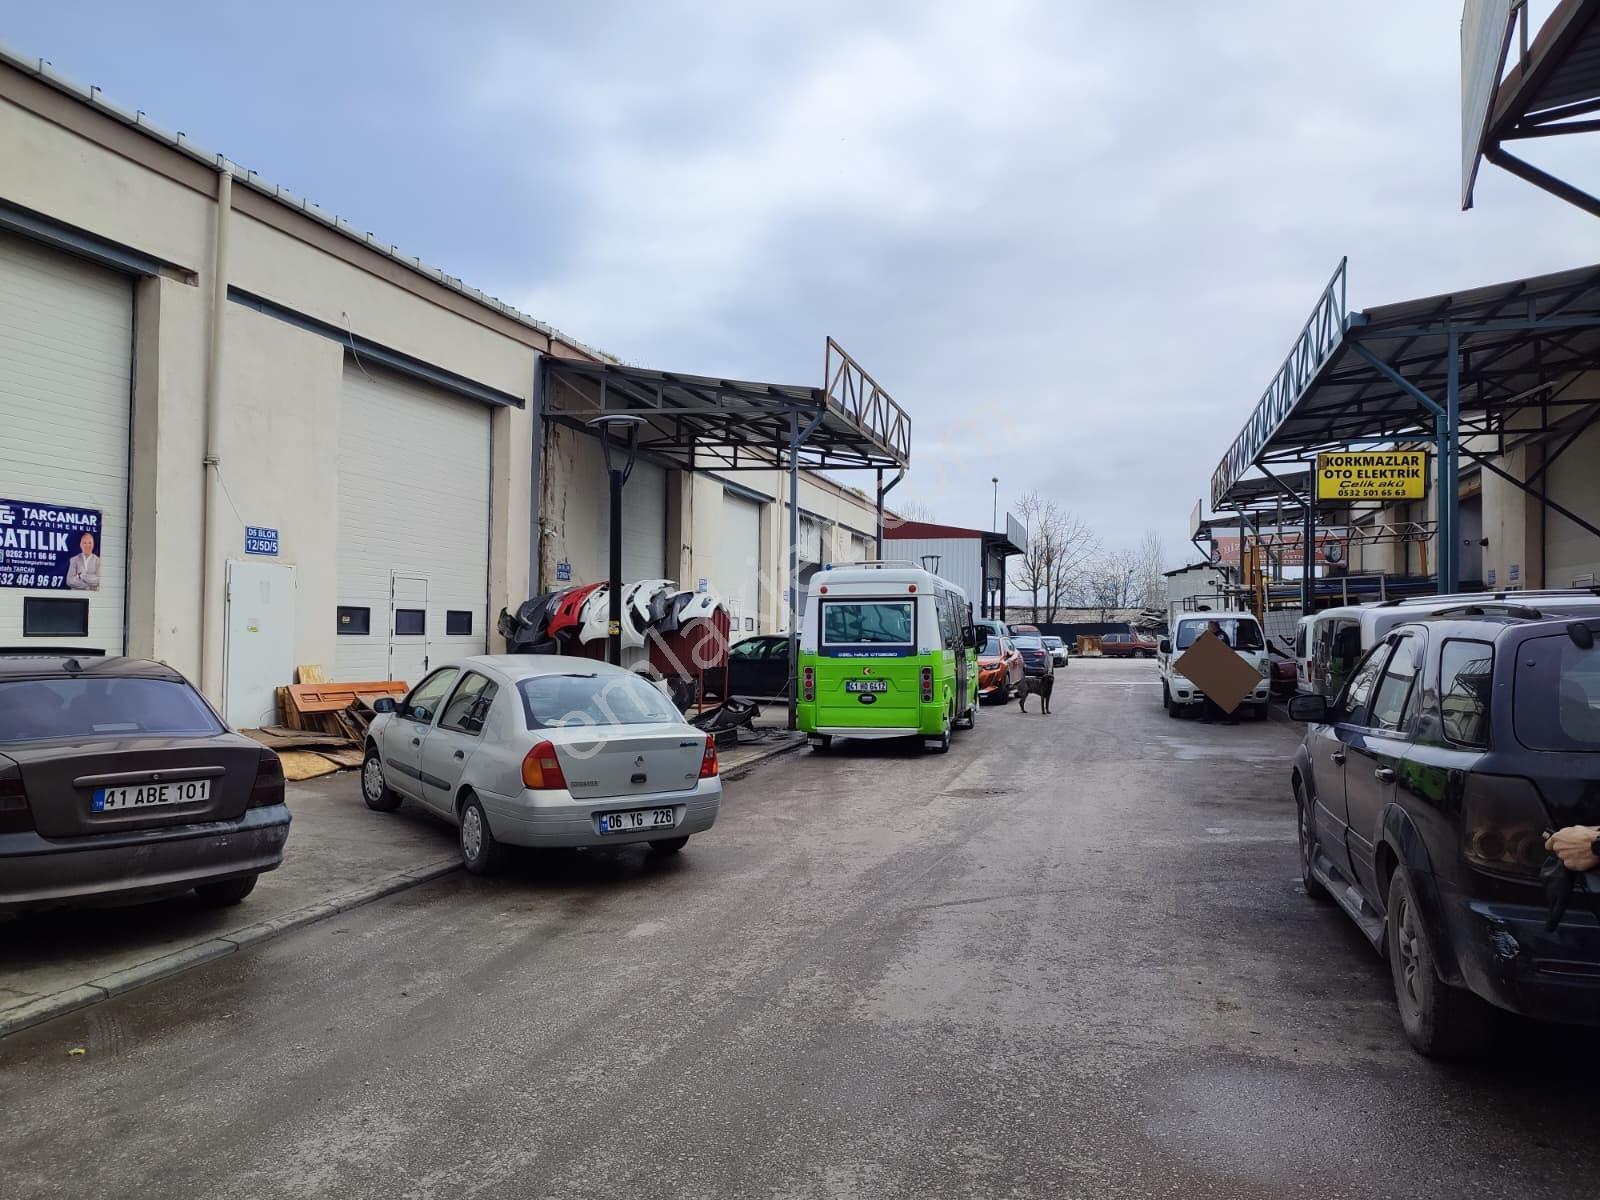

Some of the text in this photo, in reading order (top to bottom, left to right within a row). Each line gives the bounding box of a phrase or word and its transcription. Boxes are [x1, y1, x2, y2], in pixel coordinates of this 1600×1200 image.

[1326, 455, 1419, 466] KORKMAZLAR
[1324, 467, 1420, 479] OTO ELEKTRİK
[1339, 480, 1405, 490] Çelik akü
[1338, 489, 1406, 497] 0532 501 65 63
[22, 507, 97, 526] TARCANLAR
[258, 529, 277, 539] BLOK
[247, 538, 277, 553] 12/5D/5
[5, 549, 23, 558] 0262
[24, 551, 37, 560] 311
[0, 572, 64, 587] 32 464 96 87
[105, 782, 206, 807] 41 ABE 101
[608, 814, 622, 829] 06
[630, 812, 643, 827] YG
[653, 809, 672, 825] 226
